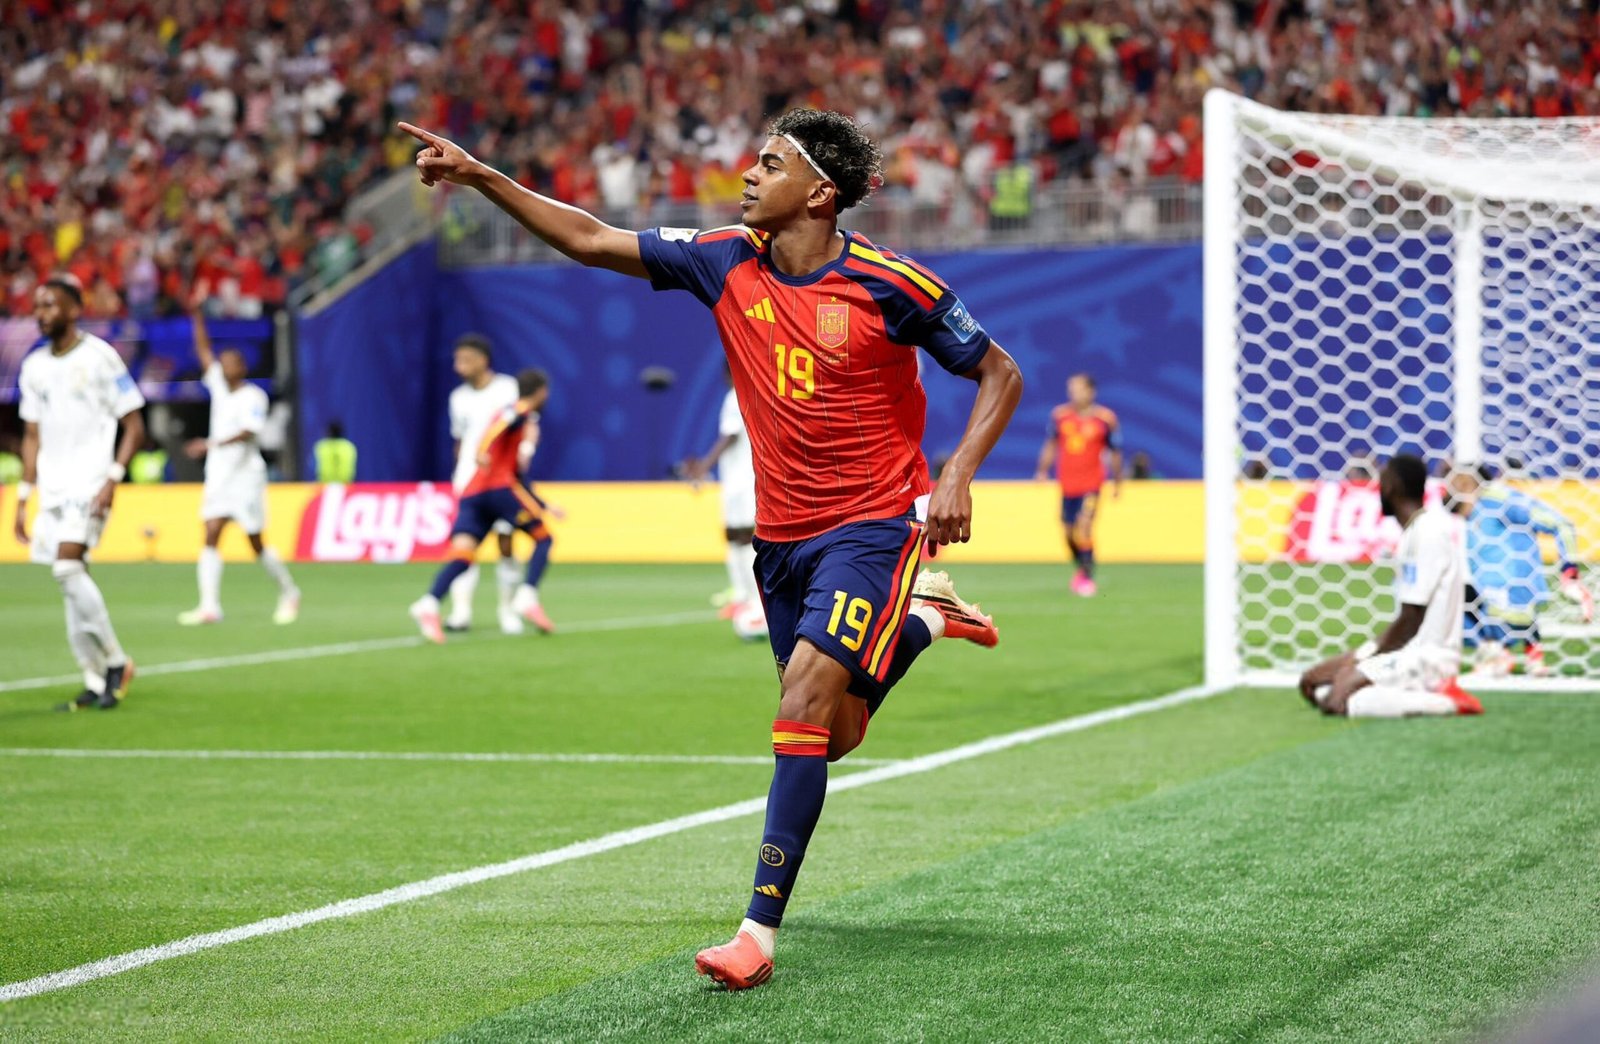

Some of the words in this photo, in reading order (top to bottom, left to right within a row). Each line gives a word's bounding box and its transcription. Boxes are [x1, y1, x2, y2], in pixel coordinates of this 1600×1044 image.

[775, 343, 815, 400] 19
[311, 480, 454, 563] Lay's
[826, 590, 873, 652] 19
